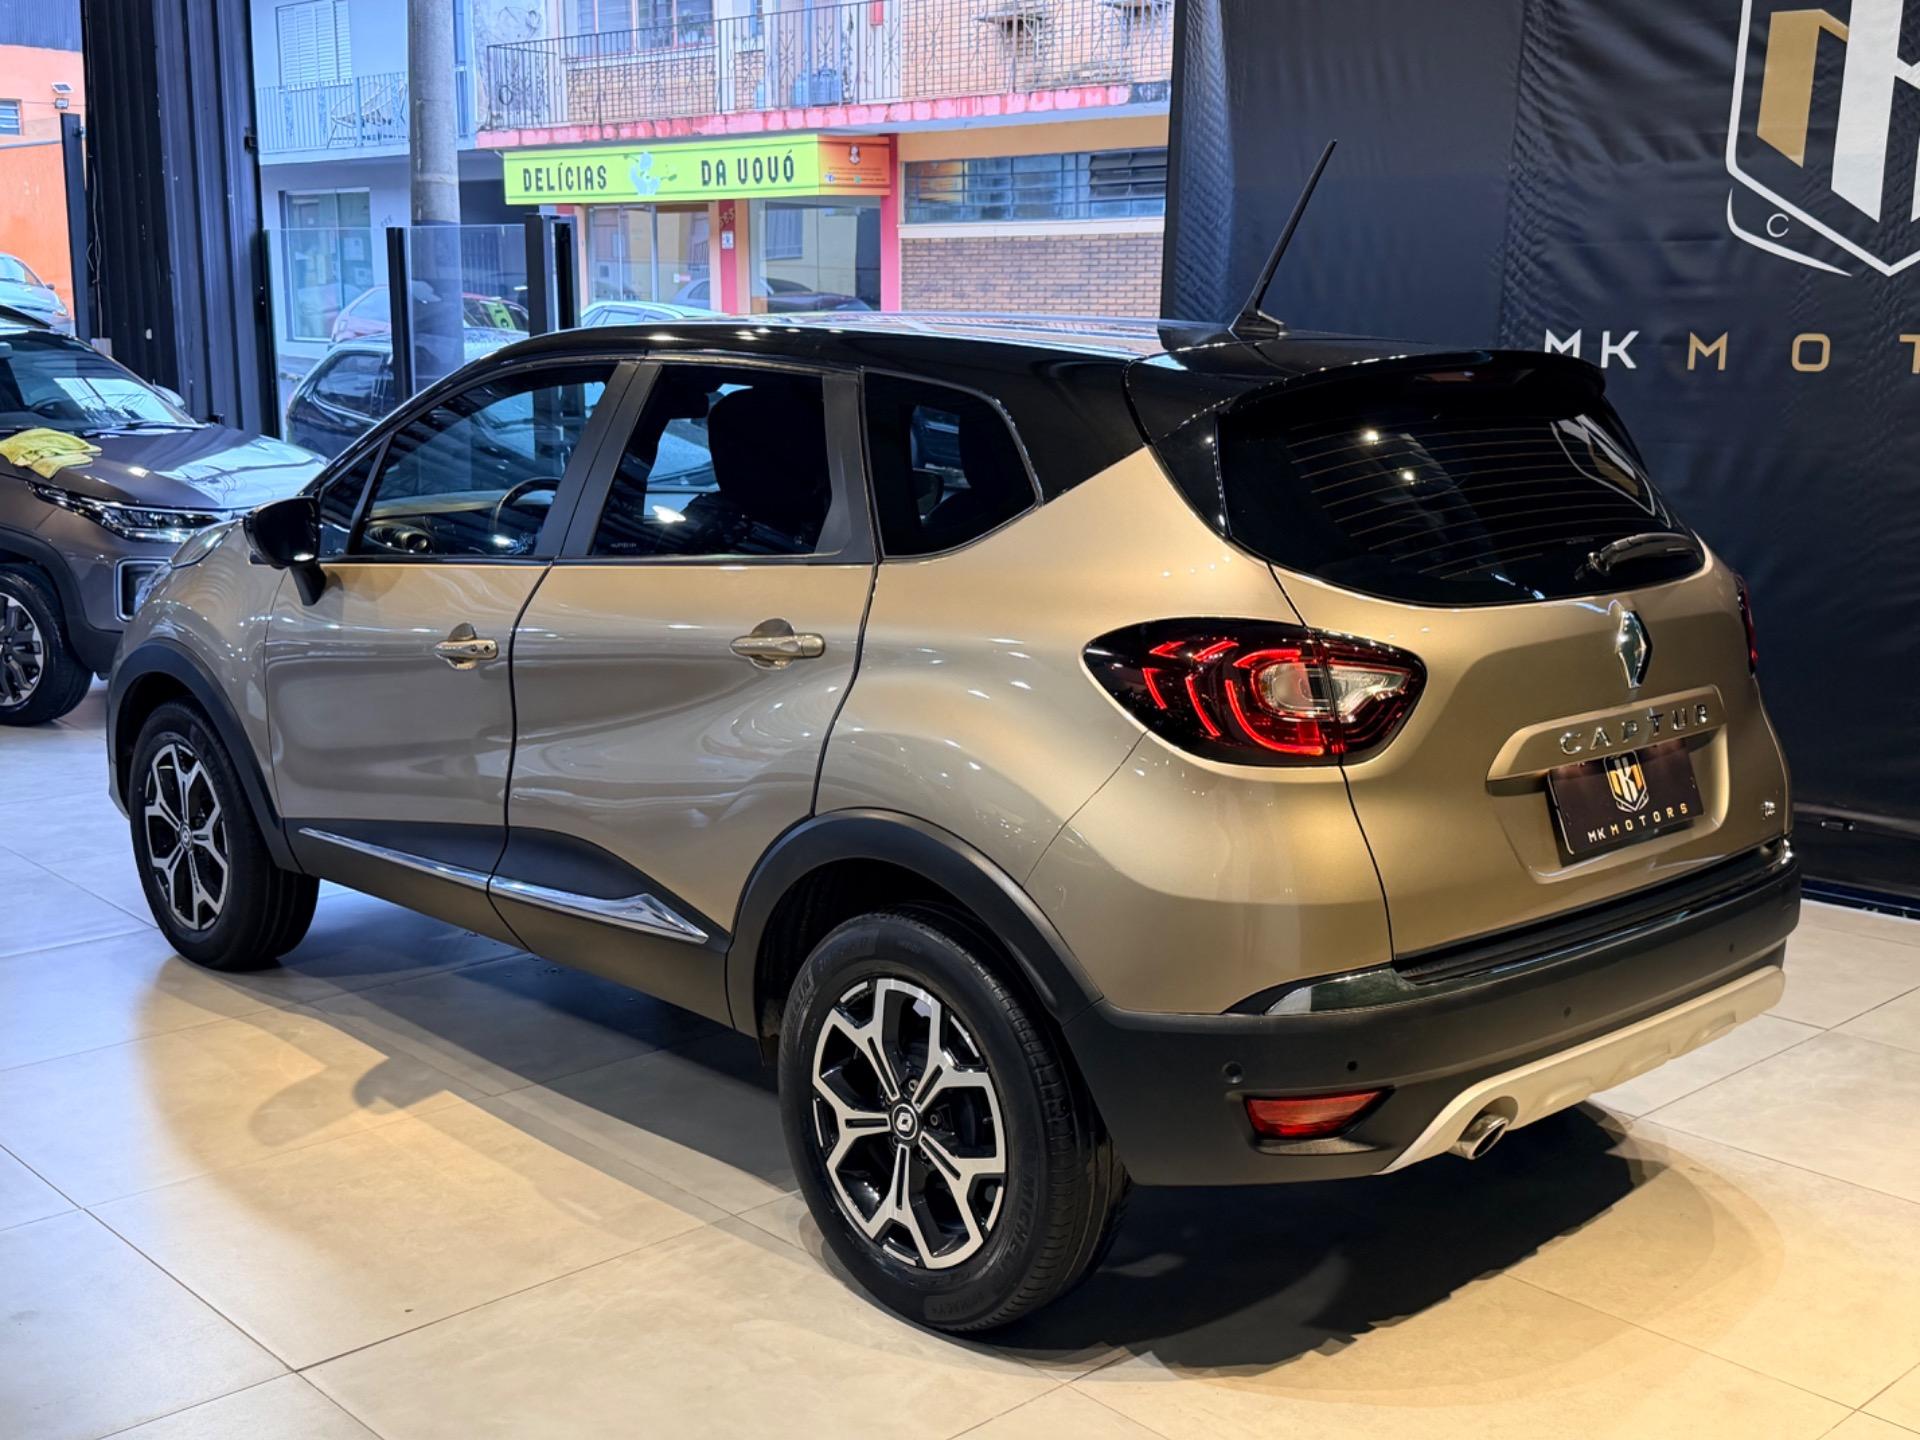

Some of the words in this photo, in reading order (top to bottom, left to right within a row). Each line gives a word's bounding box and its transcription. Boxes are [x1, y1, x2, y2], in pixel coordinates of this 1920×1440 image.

[522, 162, 608, 192] DELÍCIAS
[701, 159, 727, 186] DA
[1544, 328, 1640, 370] MK
[1560, 704, 1708, 755] CAPTUR
[1587, 827, 1607, 843] MK
[1609, 803, 1689, 836] MOTORS
